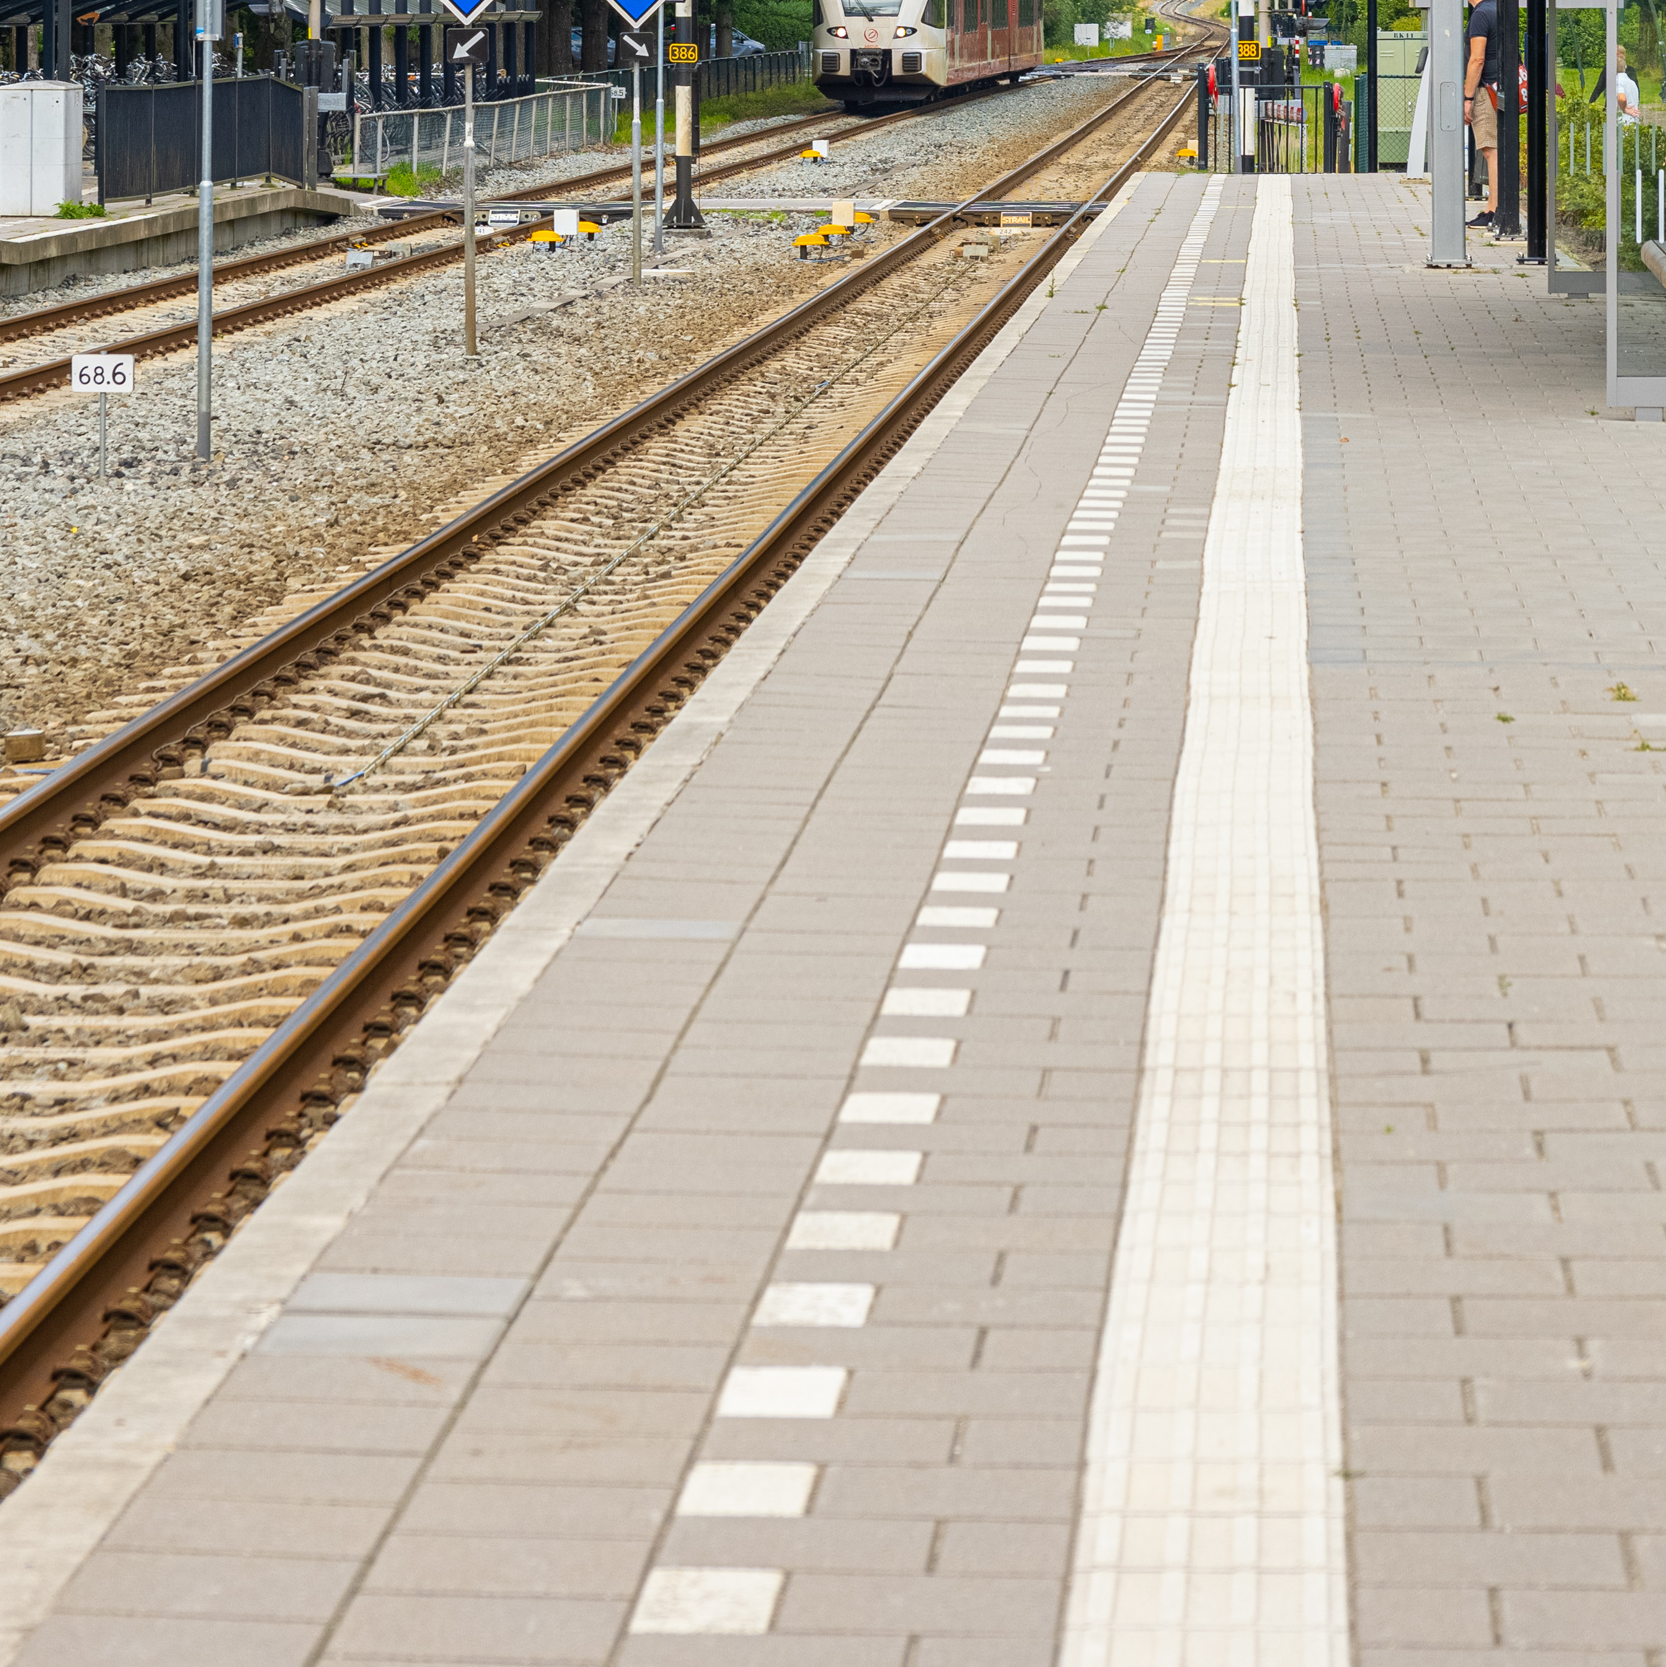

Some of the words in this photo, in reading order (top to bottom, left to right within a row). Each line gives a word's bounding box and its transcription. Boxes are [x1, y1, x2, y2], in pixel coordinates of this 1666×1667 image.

[671, 46, 696, 60] 386
[1237, 44, 1257, 57] 388
[1001, 216, 1031, 224] STRAIL
[78, 362, 126, 385] 68.6
